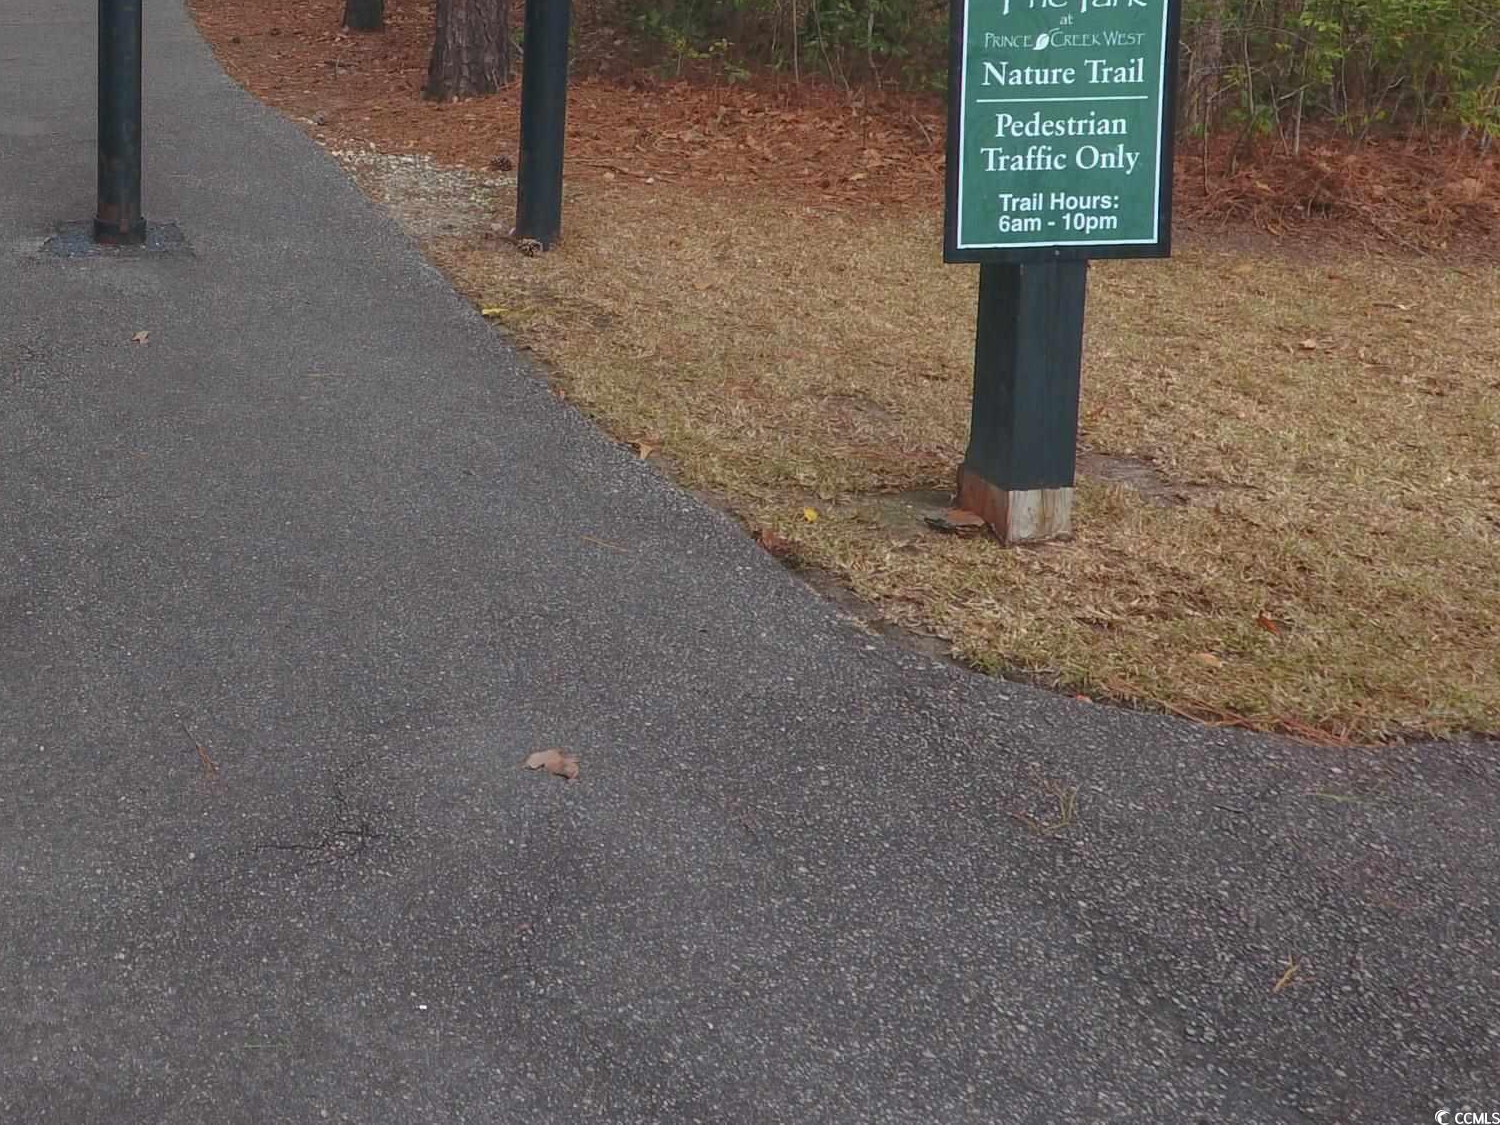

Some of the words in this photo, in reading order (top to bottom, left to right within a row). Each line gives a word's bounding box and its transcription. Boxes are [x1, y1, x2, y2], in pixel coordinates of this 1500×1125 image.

[1060, 14, 1073, 25] at
[984, 32, 1033, 48] PRINCE
[1103, 31, 1145, 45] WEST
[982, 62, 1075, 86] Nature
[1085, 58, 1144, 83] Trail
[995, 111, 1127, 137] Pedestrian
[980, 146, 1067, 171] Traffic
[1076, 144, 1140, 174] Only
[999, 193, 1043, 211] Trail
[1050, 193, 1119, 210] Hours:
[999, 216, 1041, 232] 6am
[1062, 213, 1117, 233] 10pm
